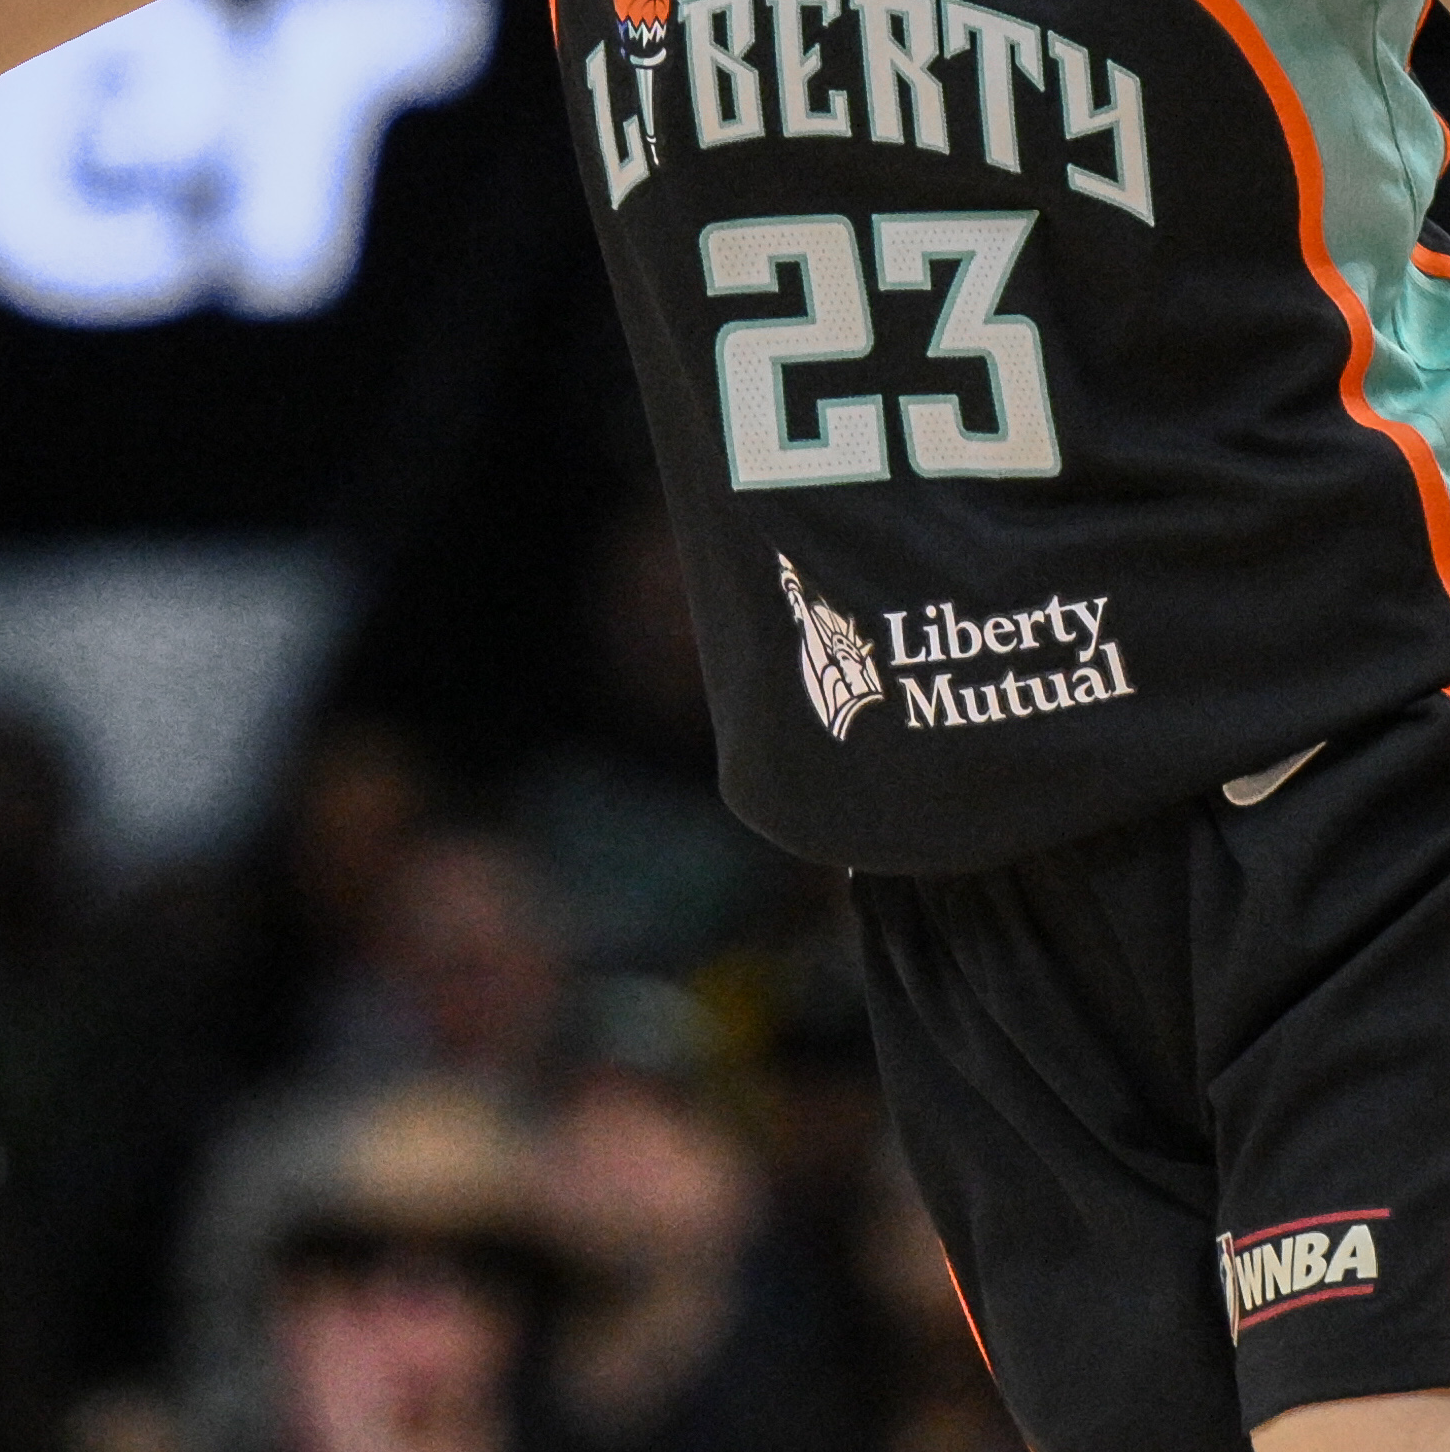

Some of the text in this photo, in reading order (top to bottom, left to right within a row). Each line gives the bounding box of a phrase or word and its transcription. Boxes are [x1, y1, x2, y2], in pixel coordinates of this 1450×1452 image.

[699, 210, 1062, 491] 23
[883, 594, 1109, 667] Liberty
[899, 642, 1135, 730] Mutual
[1235, 1223, 1379, 1311] WNBA
